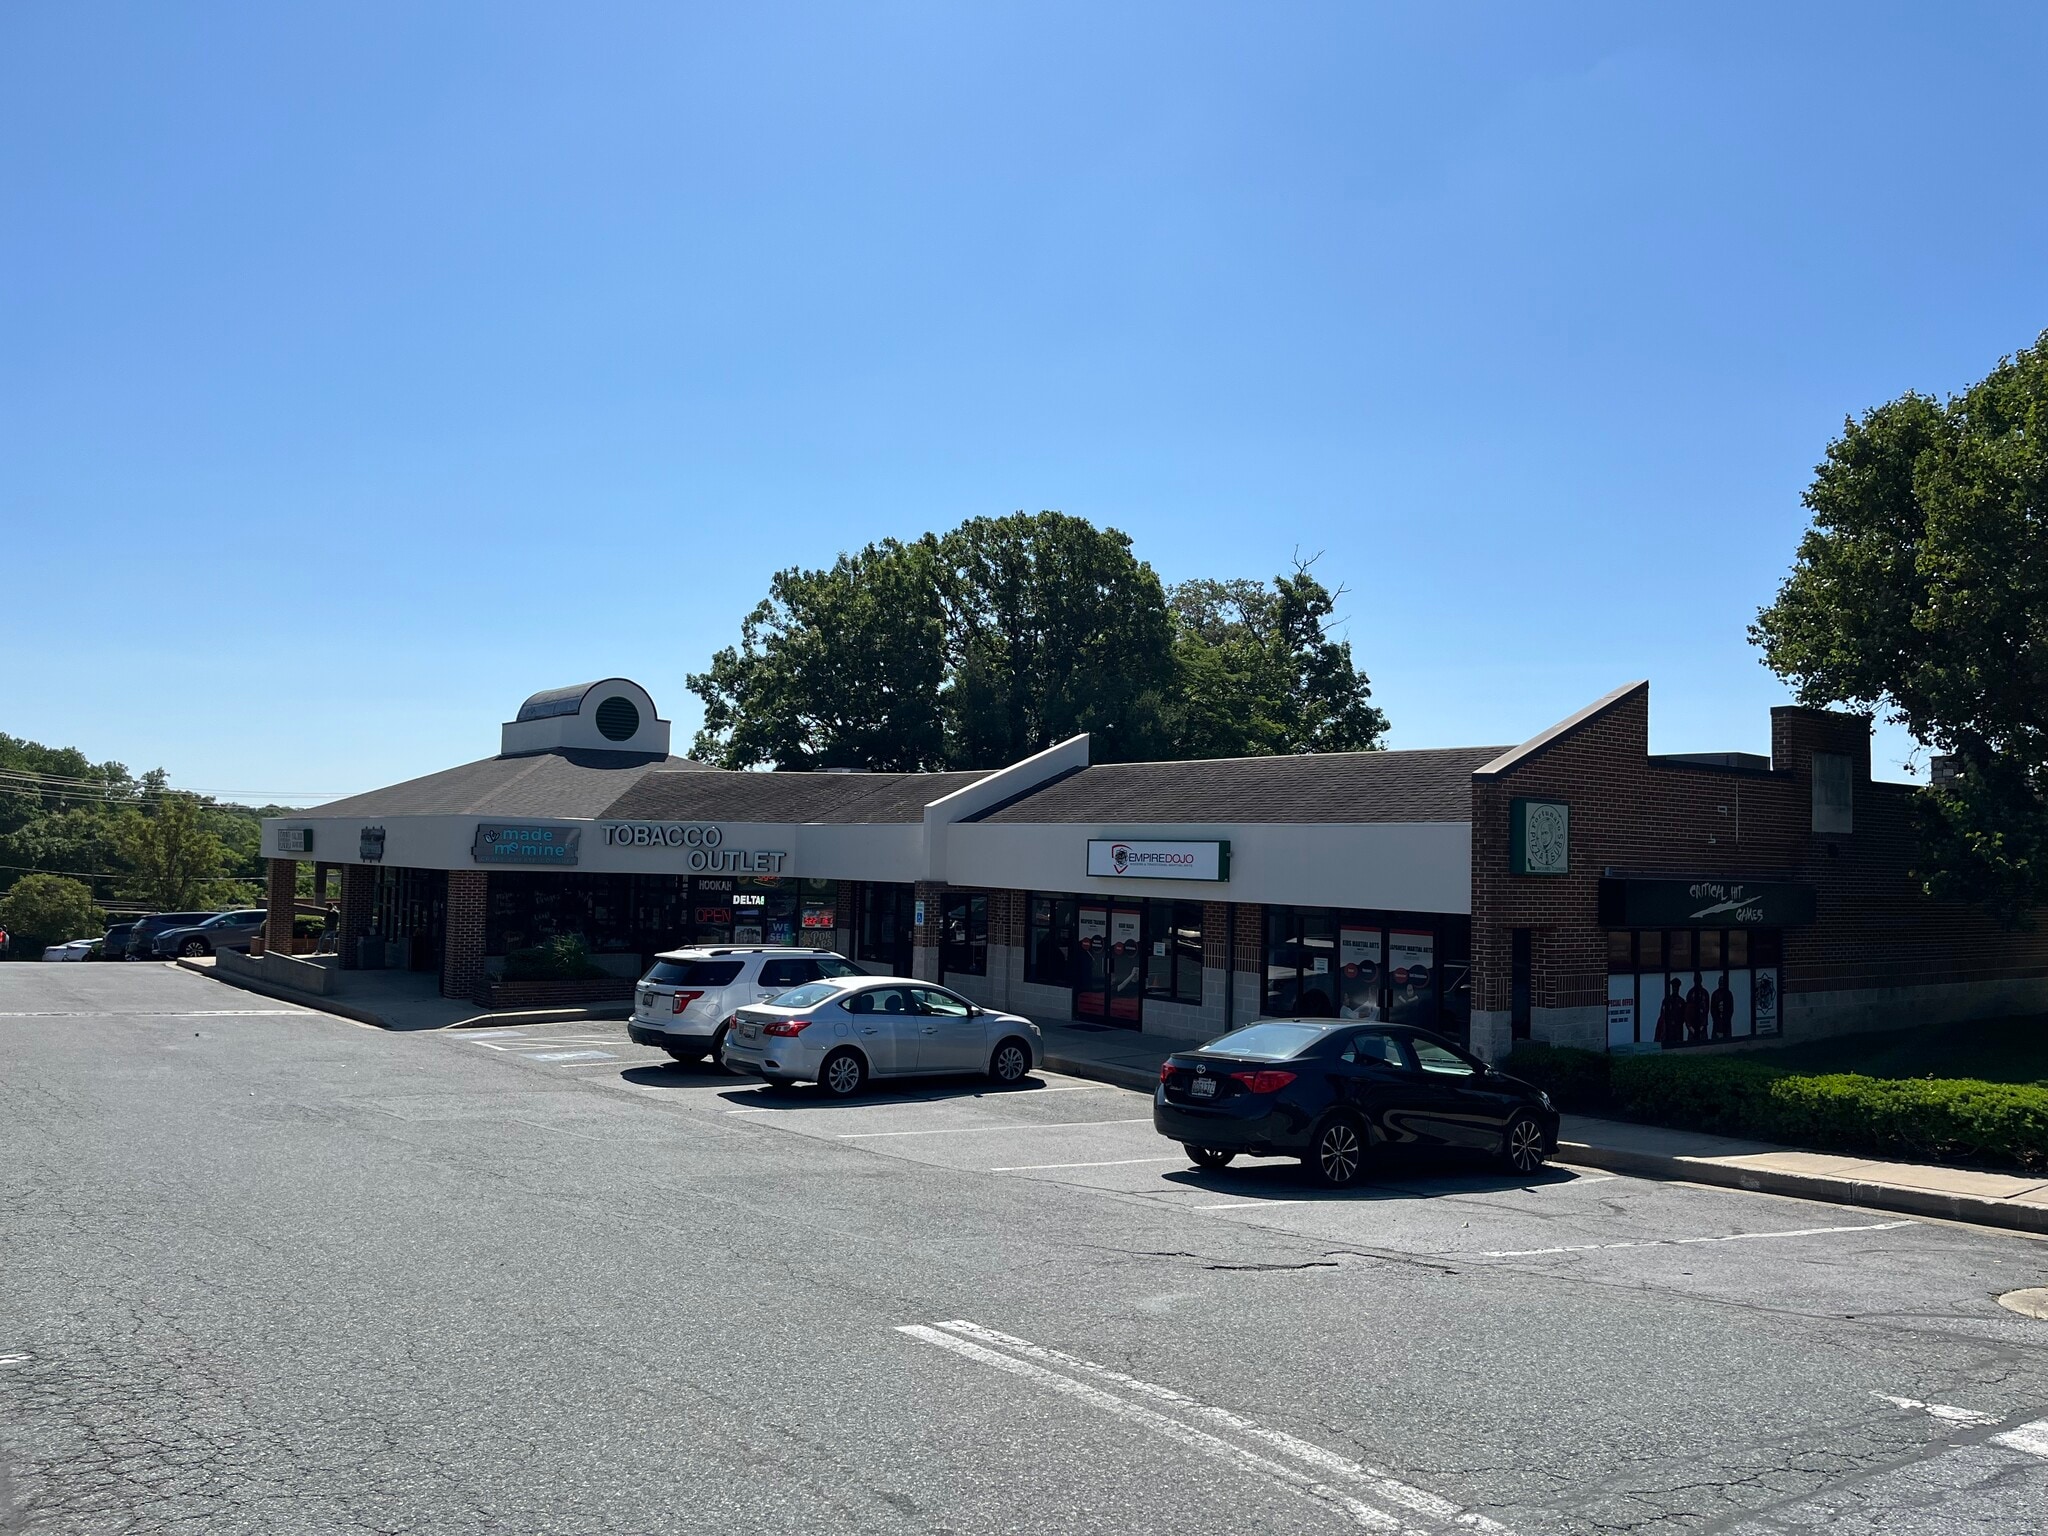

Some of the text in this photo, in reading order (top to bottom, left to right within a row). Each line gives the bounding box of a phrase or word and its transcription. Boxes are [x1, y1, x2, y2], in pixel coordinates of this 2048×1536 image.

[503, 828, 552, 841] made
[601, 824, 722, 848] TOBACCO
[495, 842, 518, 855] me
[522, 843, 564, 856] mine
[688, 850, 787, 872] OUTLET
[1129, 853, 1193, 863] EMPIREDOJO
[699, 880, 732, 891] HOOKAH
[1689, 882, 1743, 901] CRITICAL HIT
[697, 909, 731, 923] OPEN
[1735, 907, 1764, 923] GAMES
[772, 923, 790, 932] WE
[769, 932, 791, 942] SELL
